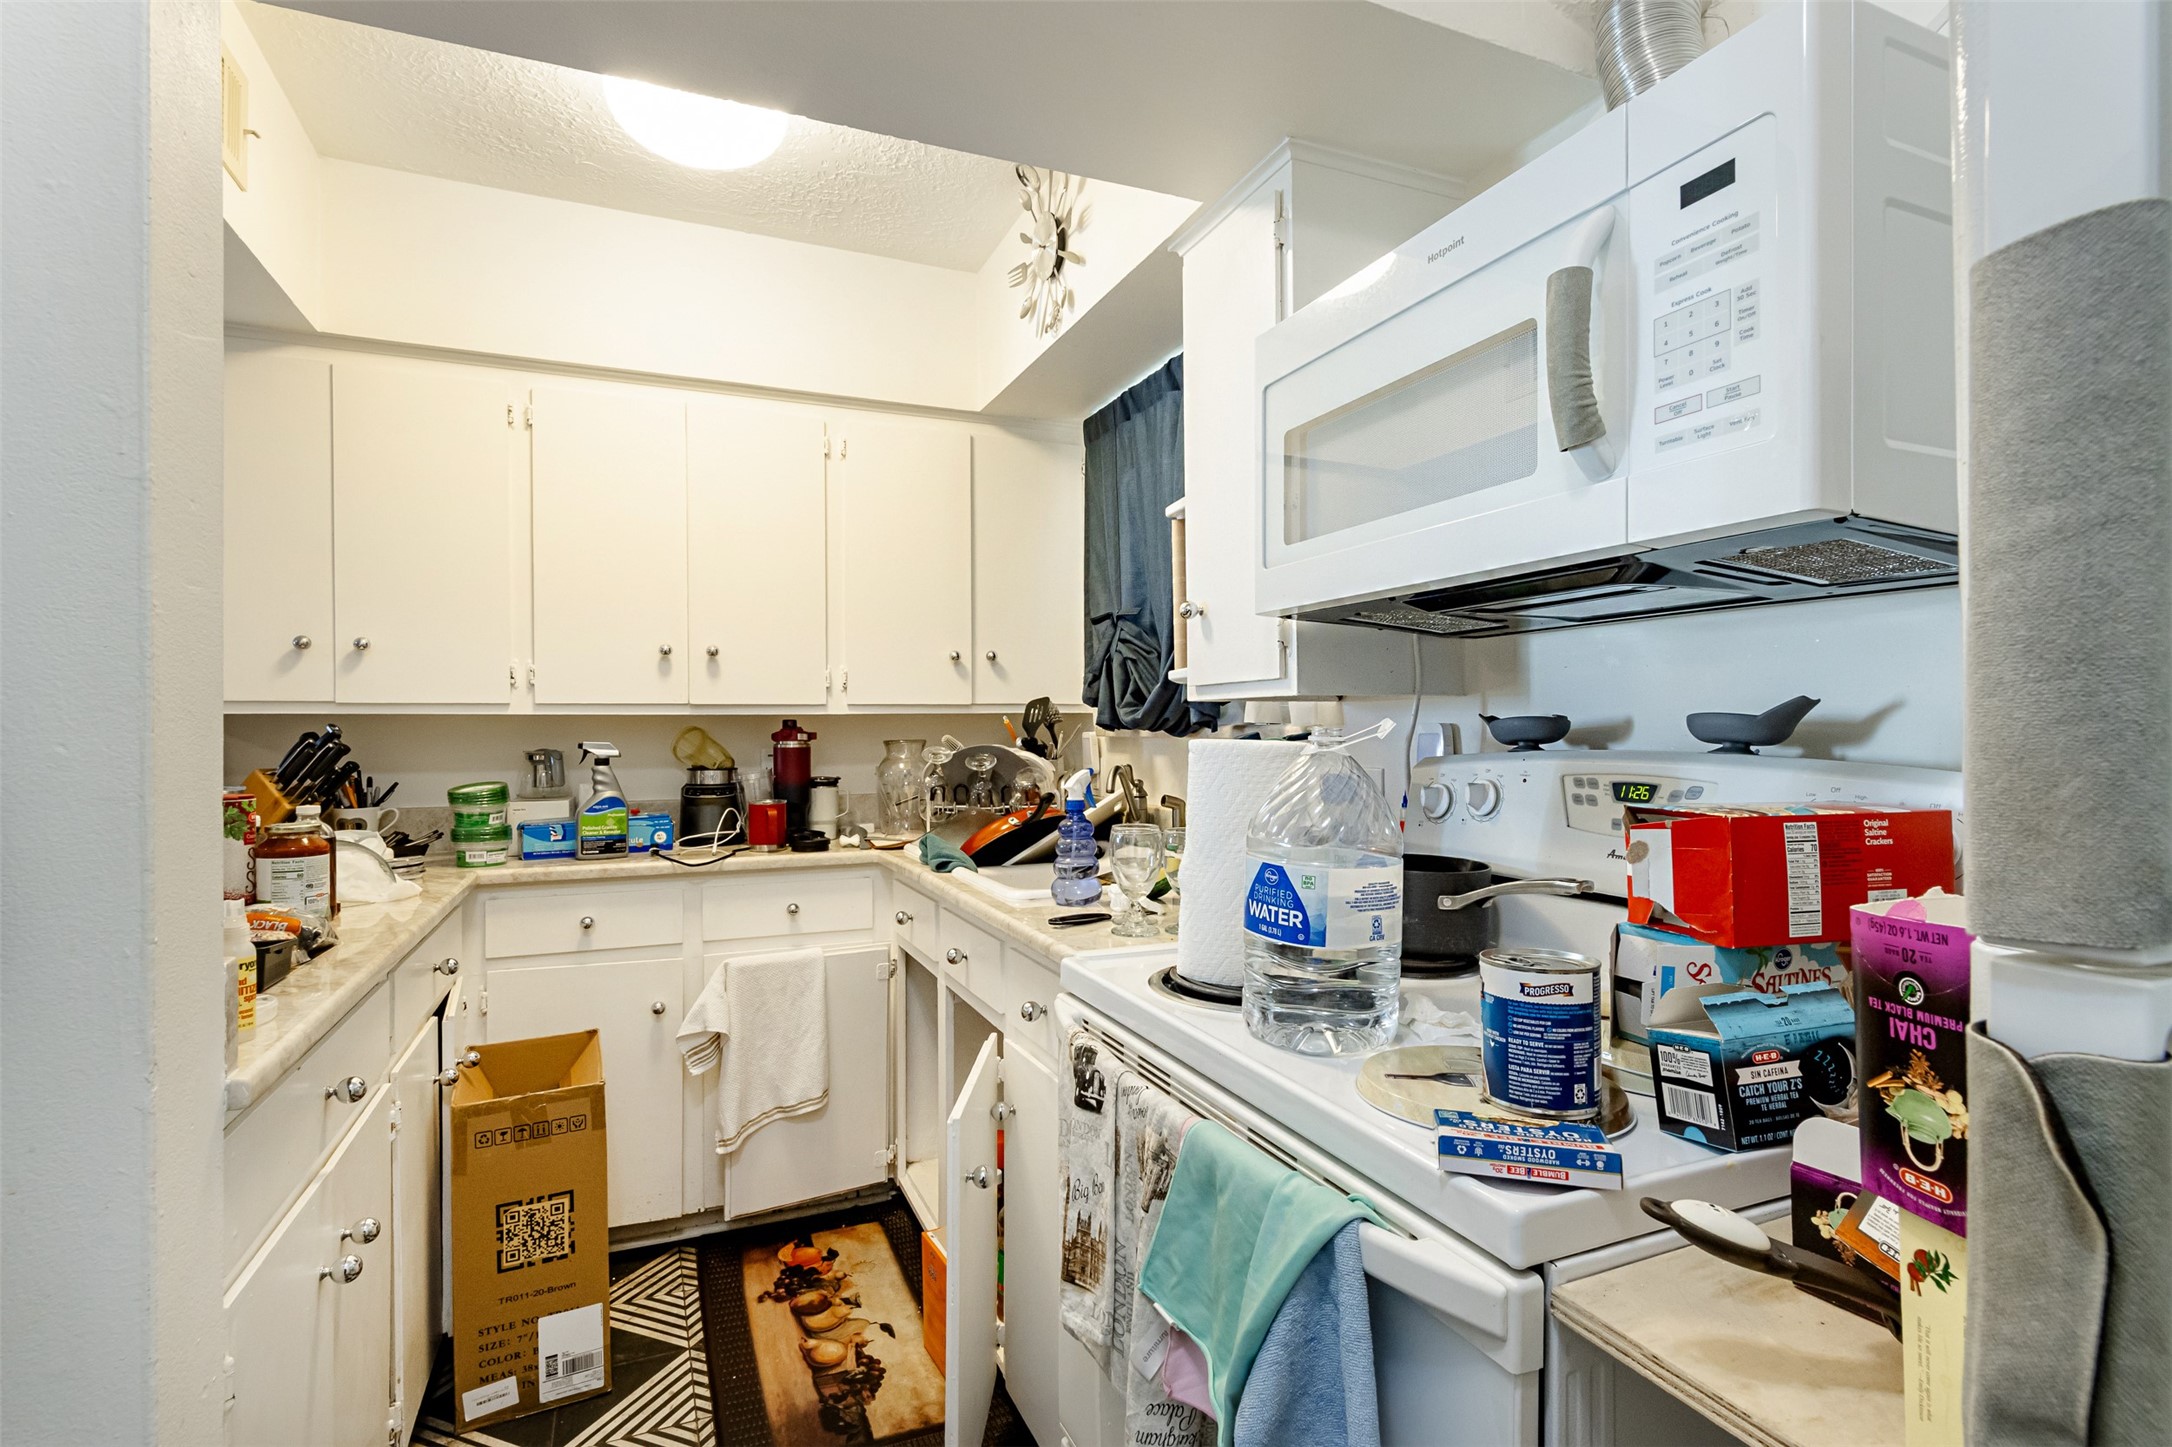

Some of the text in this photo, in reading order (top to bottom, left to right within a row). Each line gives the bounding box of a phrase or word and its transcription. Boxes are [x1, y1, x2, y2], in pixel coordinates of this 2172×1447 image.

[1671, 211, 1739, 246] Convenience Cooking
[1730, 222, 1751, 234] Potato
[1427, 235, 1465, 264] Hotpoint
[1690, 238, 1716, 253] Beverage
[1720, 244, 1742, 257] Defrost
[1659, 254, 1681, 267] Popcorn
[1669, 271, 1688, 282] Reheat
[1740, 285, 1752, 294] Add
[1671, 287, 1712, 308] Express Cook
[1739, 326, 1754, 335] Cook
[1709, 363, 1725, 372] Clock
[1658, 375, 1675, 383] Power
[1659, 381, 1673, 389] Level
[1724, 392, 1742, 400] Pause
[1668, 402, 1687, 411] Cancel
[1693, 424, 1715, 434] Surface
[1697, 431, 1711, 439] Light
[1658, 436, 1683, 446] Turntable
[1621, 785, 1650, 800] 11:26
[1863, 818, 1889, 829] Original
[1864, 828, 1887, 836] Saltine
[1810, 843, 1818, 851] 70
[1865, 837, 1893, 845] Crackers
[1254, 883, 1293, 900] PURIFIED
[1253, 891, 1294, 909] DRINKING
[1248, 898, 1303, 929] WATER
[250, 919, 289, 932] BLACK
[1868, 917, 1949, 946] NET WT. 1.6 OZ (45g)
[1774, 953, 1792, 967] Kroger
[1901, 947, 1917, 965] 20
[1919, 955, 1932, 964] TEA
[1524, 984, 1569, 996] PROGRESSO
[1781, 1016, 1792, 1026] 20
[1868, 996, 1963, 1033] PREMIUM BLACK TEA
[1888, 1016, 1937, 1051] CHAI
[1508, 1037, 1522, 1045] READY
[1660, 1050, 1681, 1065] 100%
[1750, 1070, 1761, 1080] SIN
[1739, 1077, 1803, 1098] CATCH YOUR Z'S
[1745, 1091, 1799, 1106] PREMIUM HERBAL TEA
[1768, 1101, 1788, 1110] HERBAL
[1463, 1119, 1580, 1139] OYSTERS
[1740, 1136, 1750, 1145] NET
[1766, 1132, 1774, 1141] OZ
[1505, 1145, 1556, 1159] OYSTERS
[1502, 1154, 1560, 1166] HARDWOOD SMOKED
[1510, 1166, 1567, 1180] BUMBLE BEE
[1071, 1178, 1089, 1204] Big
[498, 1281, 577, 1305] TR011-20-Brown
[1112, 1236, 1127, 1359] LONDON
[478, 1321, 517, 1338] STYLE
[478, 1338, 511, 1353] SIZE:
[1142, 1329, 1169, 1363] furniture
[478, 1350, 527, 1369] COLOR:
[478, 1369, 517, 1385] MEAS:
[1145, 1403, 1197, 1431] Palace
